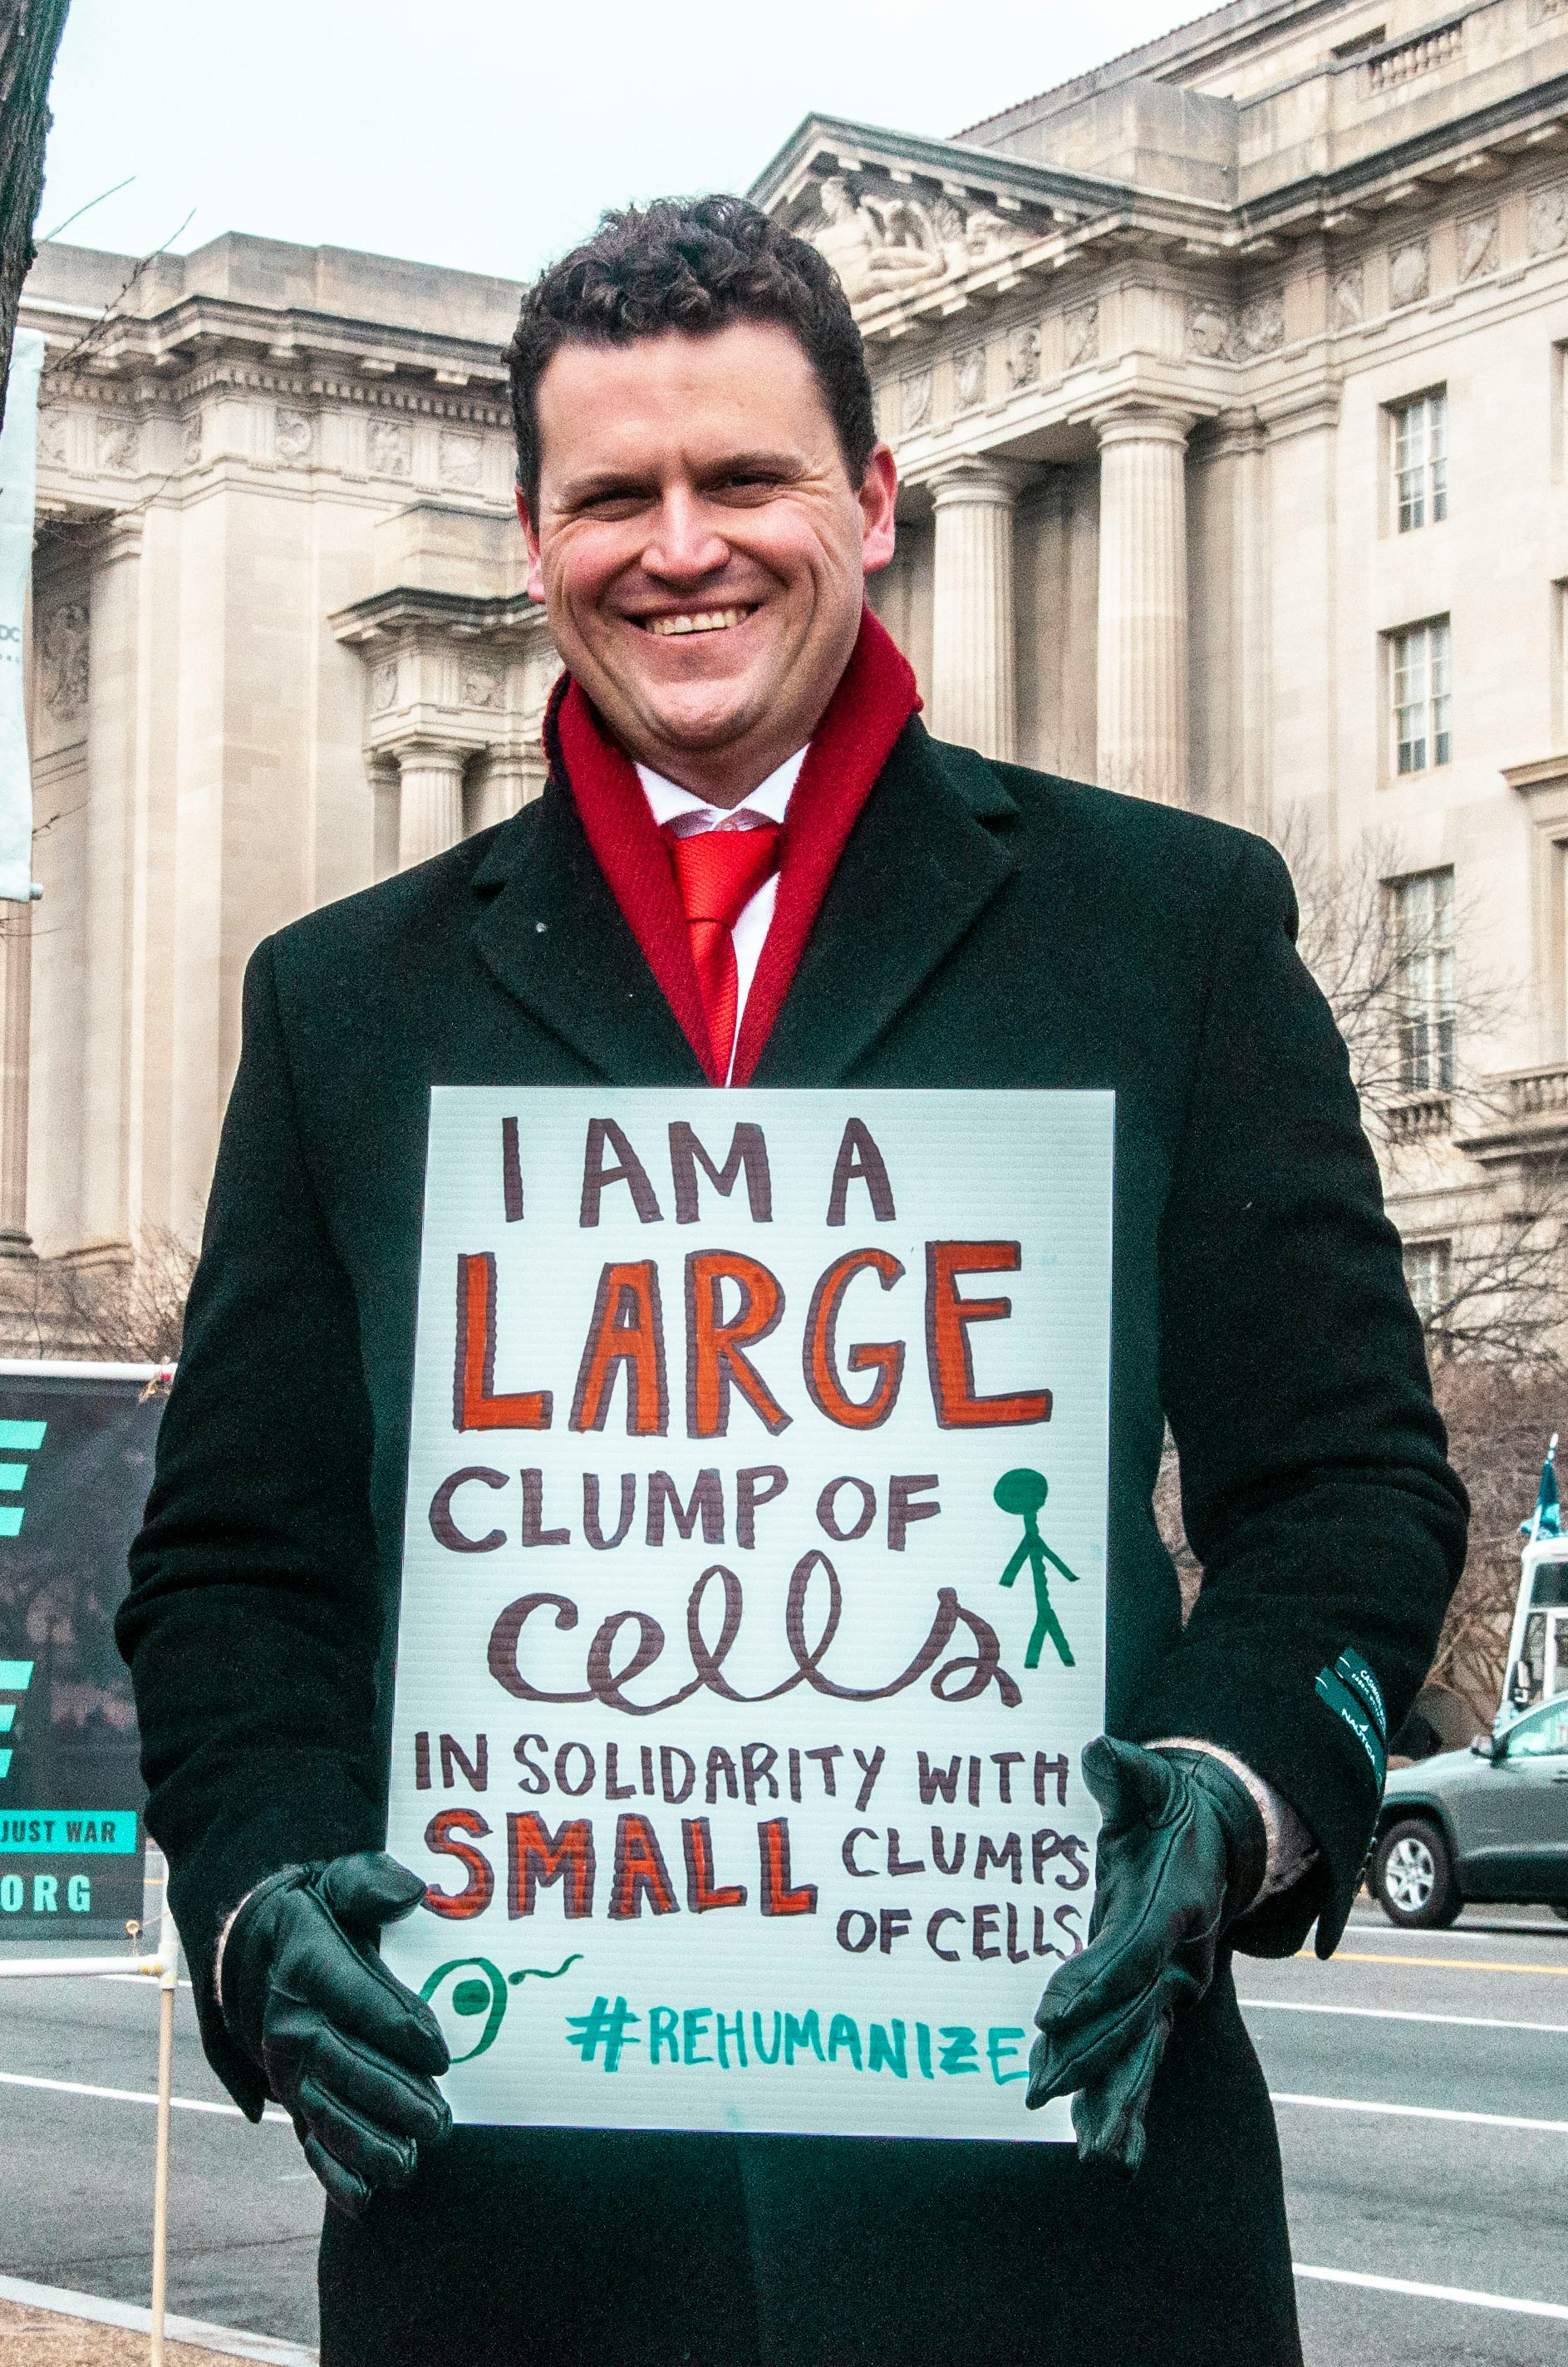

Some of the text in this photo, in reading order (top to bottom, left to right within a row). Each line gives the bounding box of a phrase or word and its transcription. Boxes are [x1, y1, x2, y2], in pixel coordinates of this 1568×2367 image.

[501, 1116, 897, 1228] I AM A
[452, 1239, 1054, 1439] LARGE
[428, 1464, 941, 1553] CLUMP OF
[415, 1731, 1069, 1813] IN SOLIDARITY WITH
[1340, 1708, 1376, 1765] NAUTICA
[66, 1820, 117, 1843] WAR
[423, 1807, 1089, 1922] SMALL CLUMPS
[0, 1873, 91, 1913] ORG
[836, 1902, 1084, 1964] OF CELLS
[565, 1995, 1030, 2086] #REHUMANIZE
